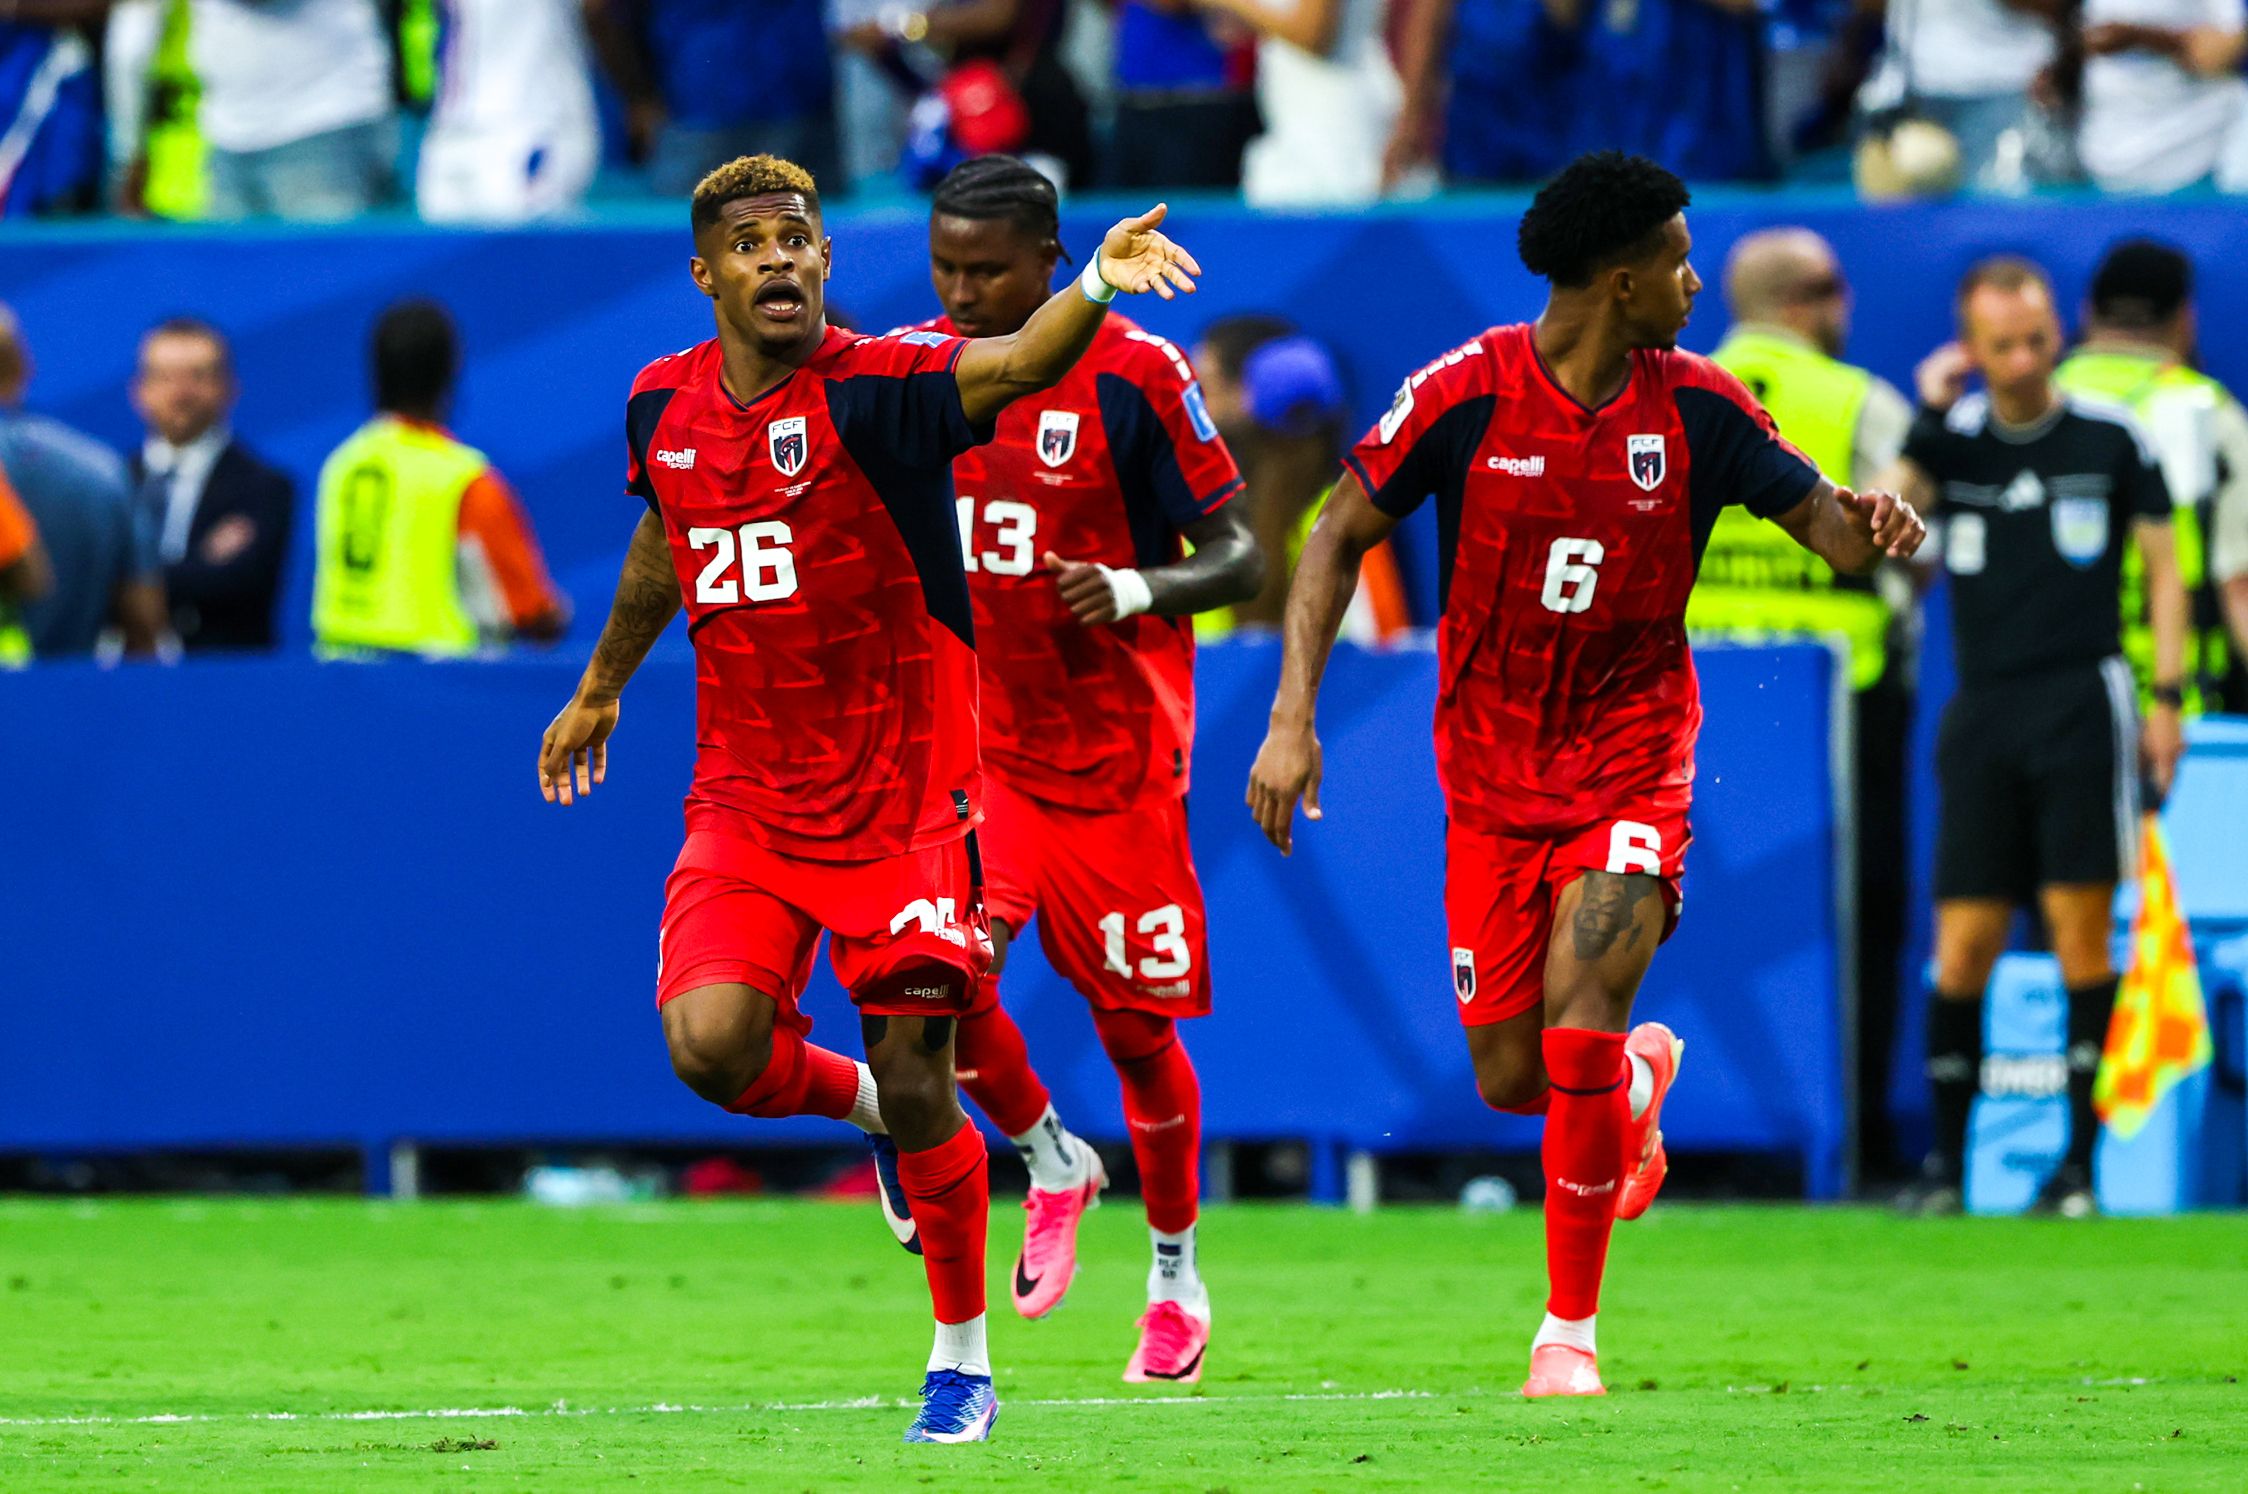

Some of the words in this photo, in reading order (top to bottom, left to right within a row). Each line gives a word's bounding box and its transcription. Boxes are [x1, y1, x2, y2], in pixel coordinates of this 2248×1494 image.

[771, 420, 803, 434] FCF
[656, 448, 697, 467] capelli
[670, 462, 695, 470] SPORT
[1487, 455, 1545, 475] capelli
[688, 520, 798, 604] 26
[1541, 537, 1604, 613] 6
[1605, 819, 1662, 876] 6
[1098, 903, 1191, 979] 13
